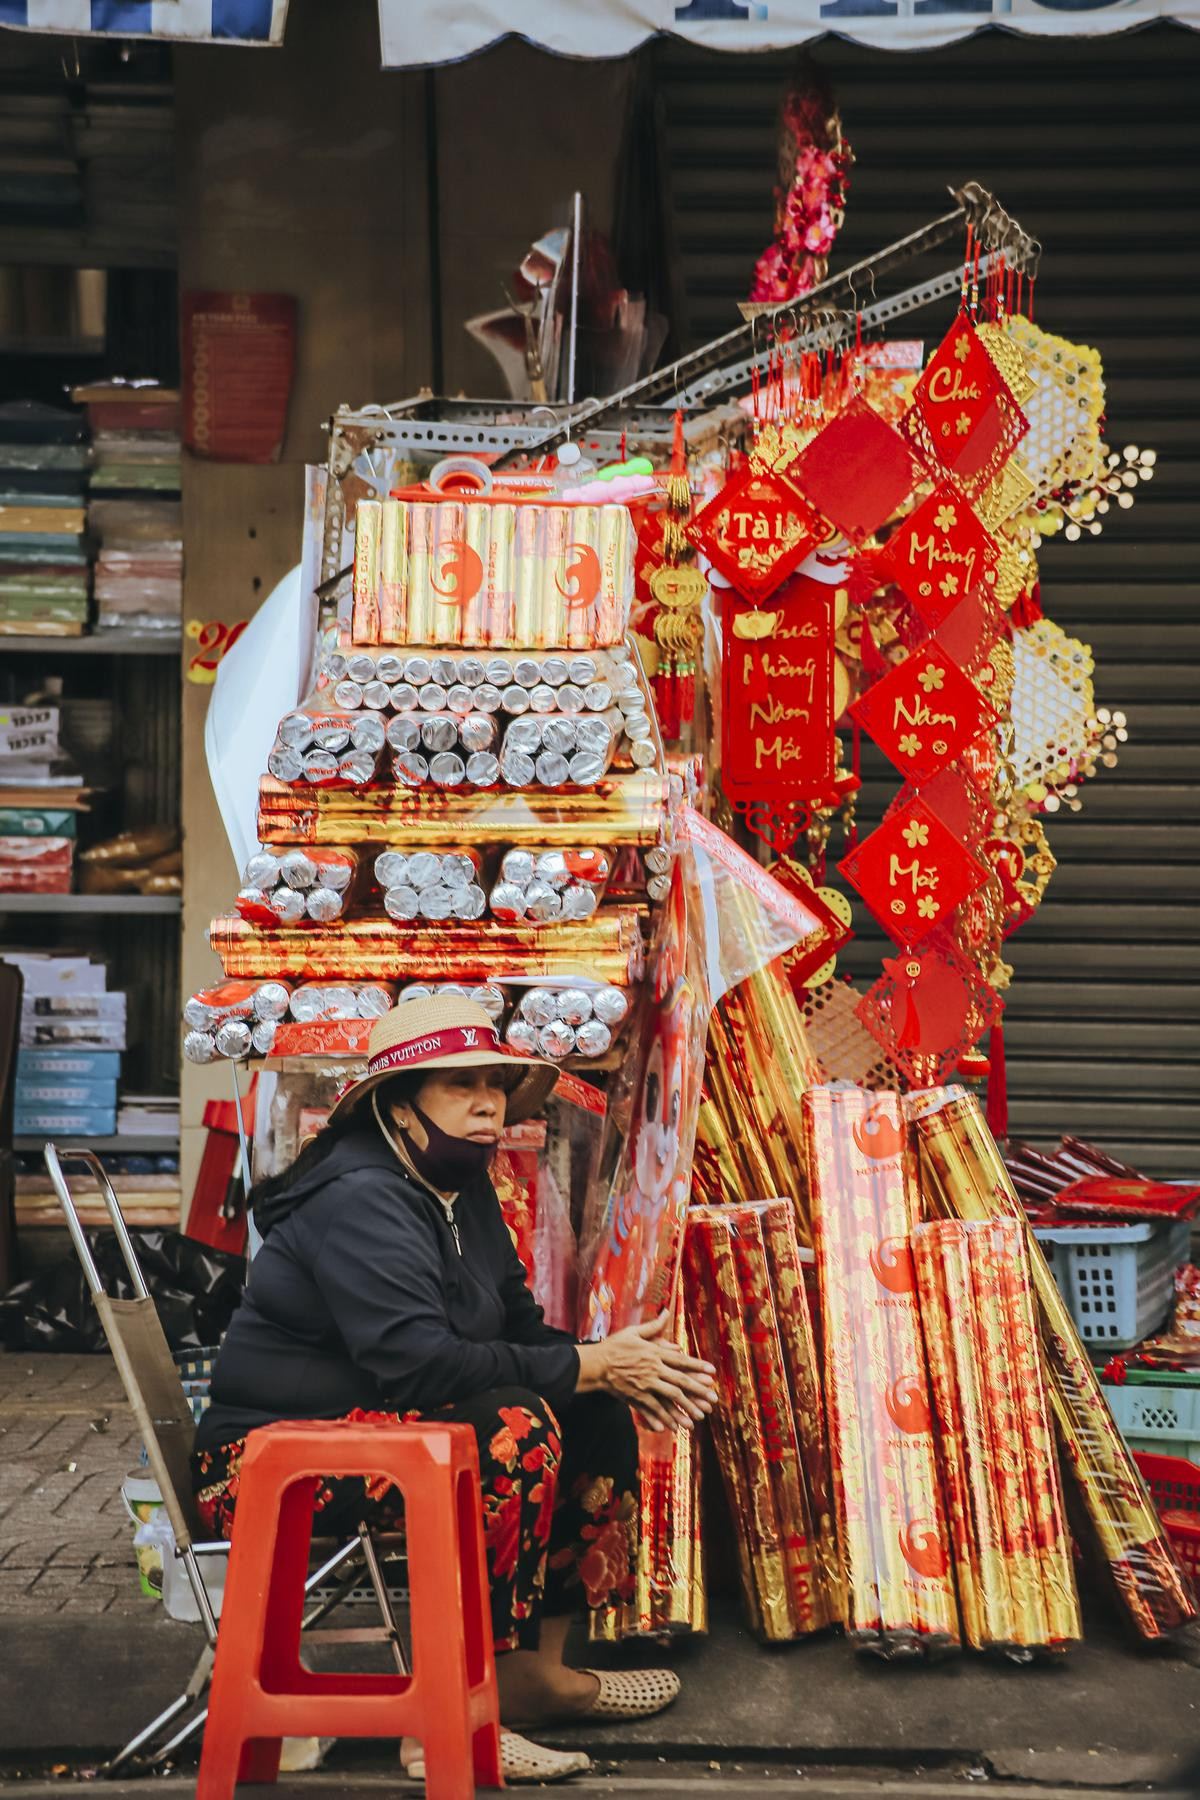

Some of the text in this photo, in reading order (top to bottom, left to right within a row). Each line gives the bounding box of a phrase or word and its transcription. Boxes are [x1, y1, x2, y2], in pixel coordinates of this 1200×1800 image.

[733, 511, 784, 539] Tài
[893, 694, 956, 732] Năm
[390, 1037, 442, 1063] VUITTON
